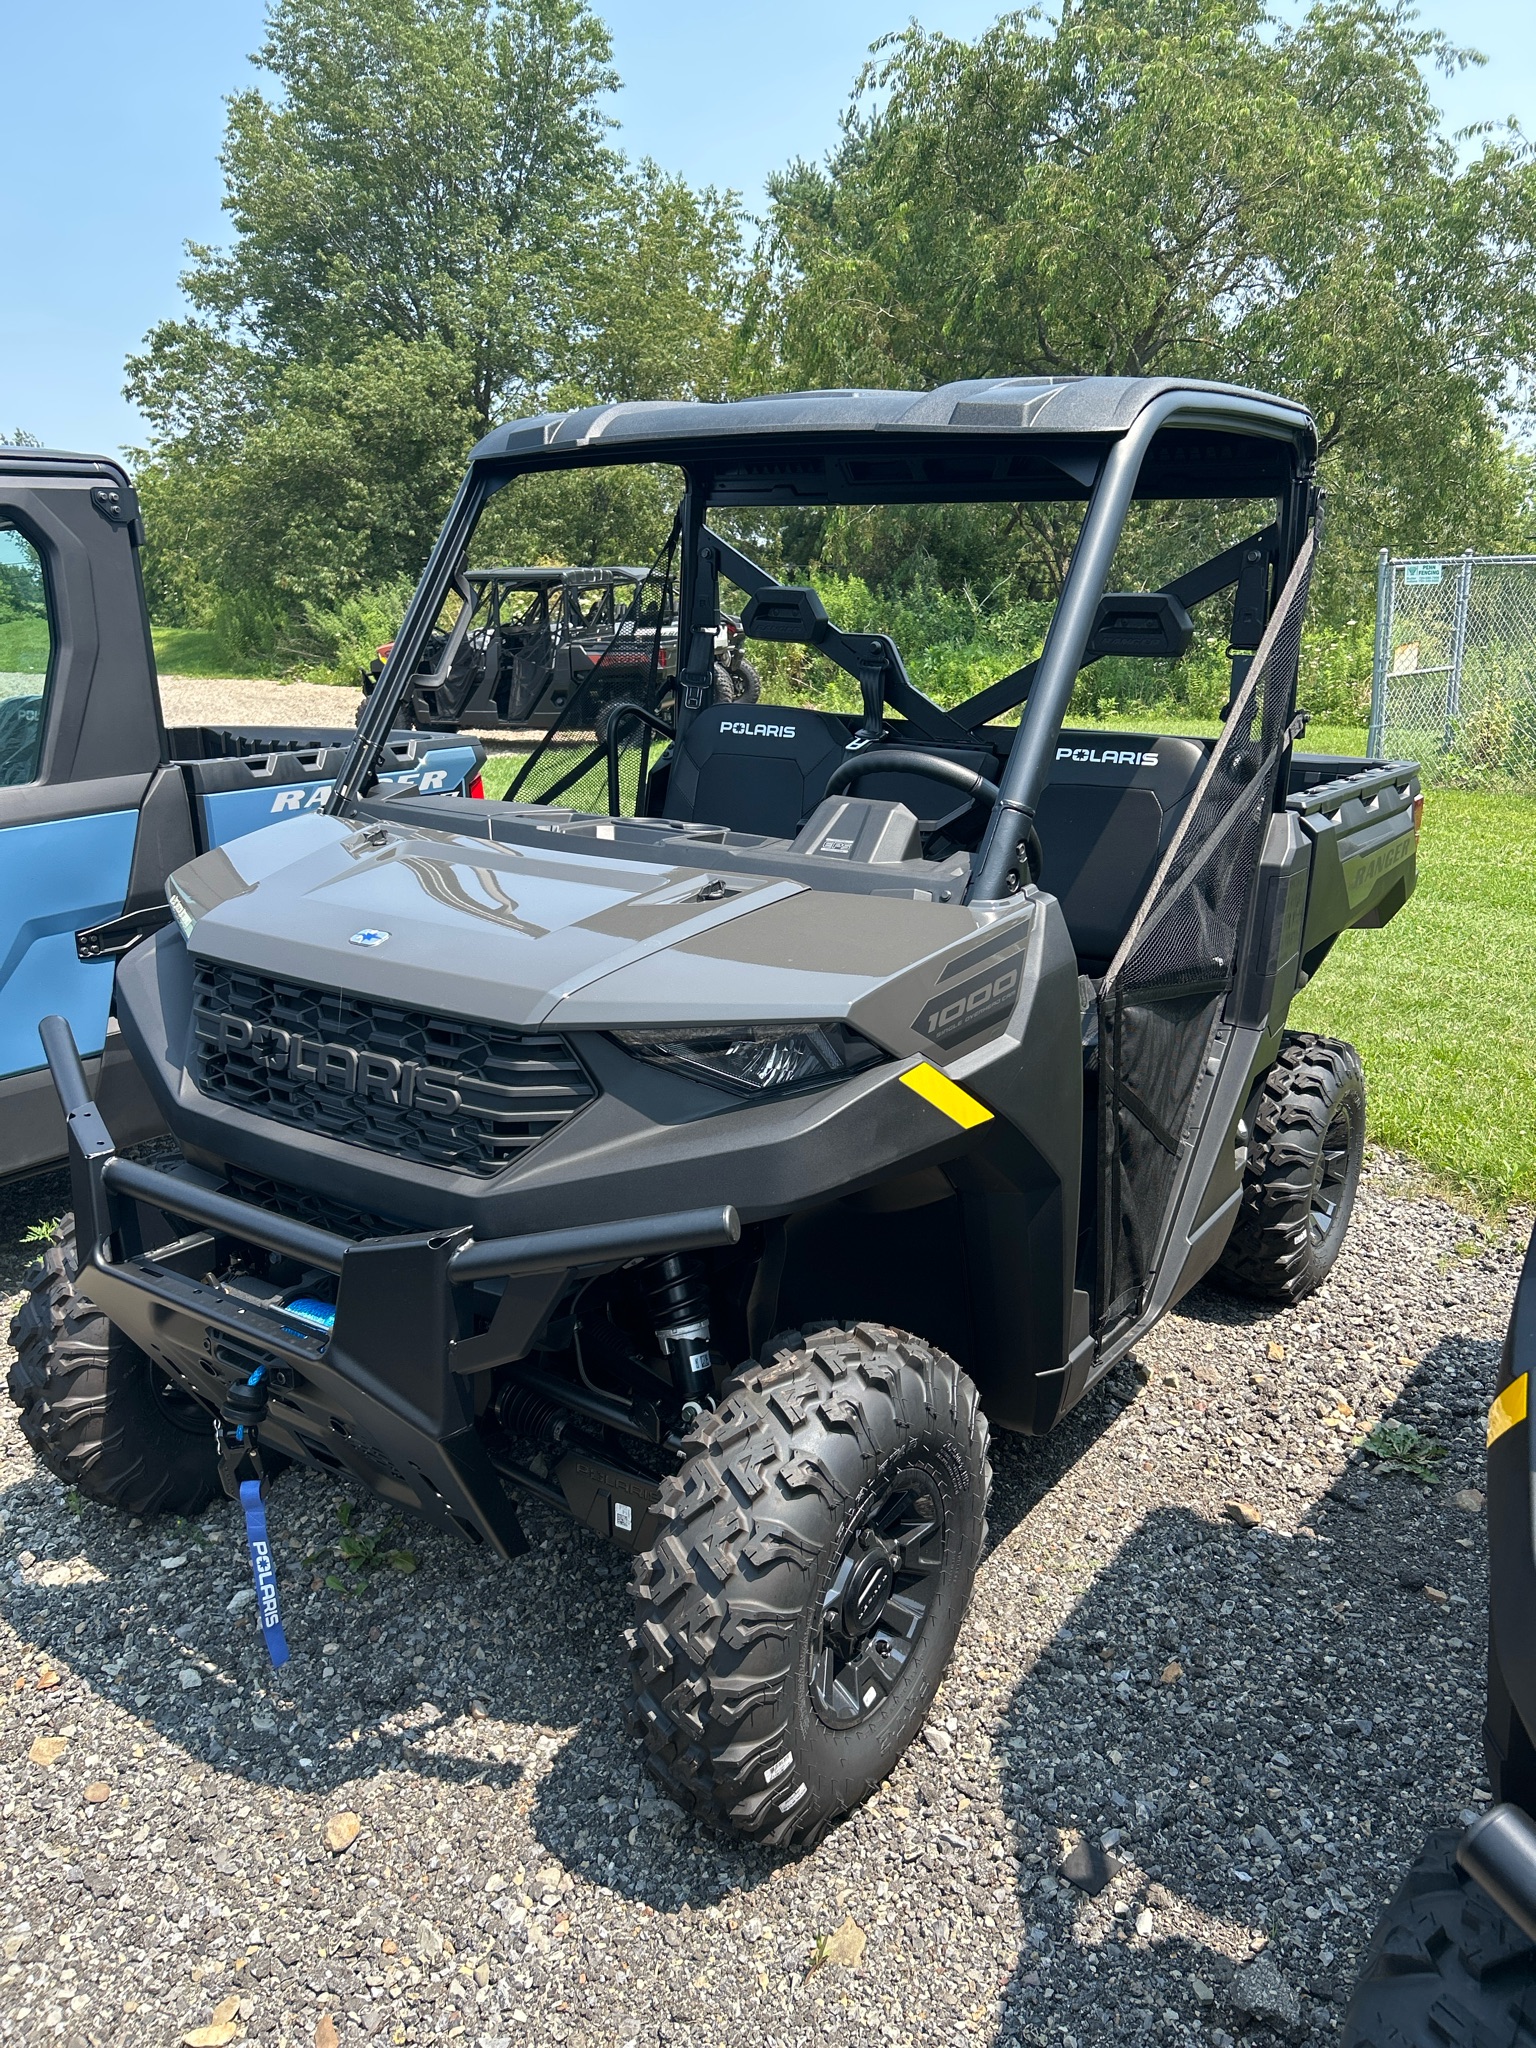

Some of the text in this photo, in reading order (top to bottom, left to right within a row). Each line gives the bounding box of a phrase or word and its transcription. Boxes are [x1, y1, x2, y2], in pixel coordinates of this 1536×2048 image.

[720, 721, 796, 739] POLARIS
[1055, 747, 1159, 767] POLARIS
[270, 770, 448, 814] RAER
[1354, 838, 1411, 889] RANGER
[927, 968, 1018, 1034] 1000
[936, 1019, 963, 1039] SINGLE
[964, 999, 1001, 1023] OVERHEAD
[218, 1012, 463, 1116] POLARIS
[576, 1463, 662, 1503] POLARIS
[252, 1541, 279, 1629] POLARIS
